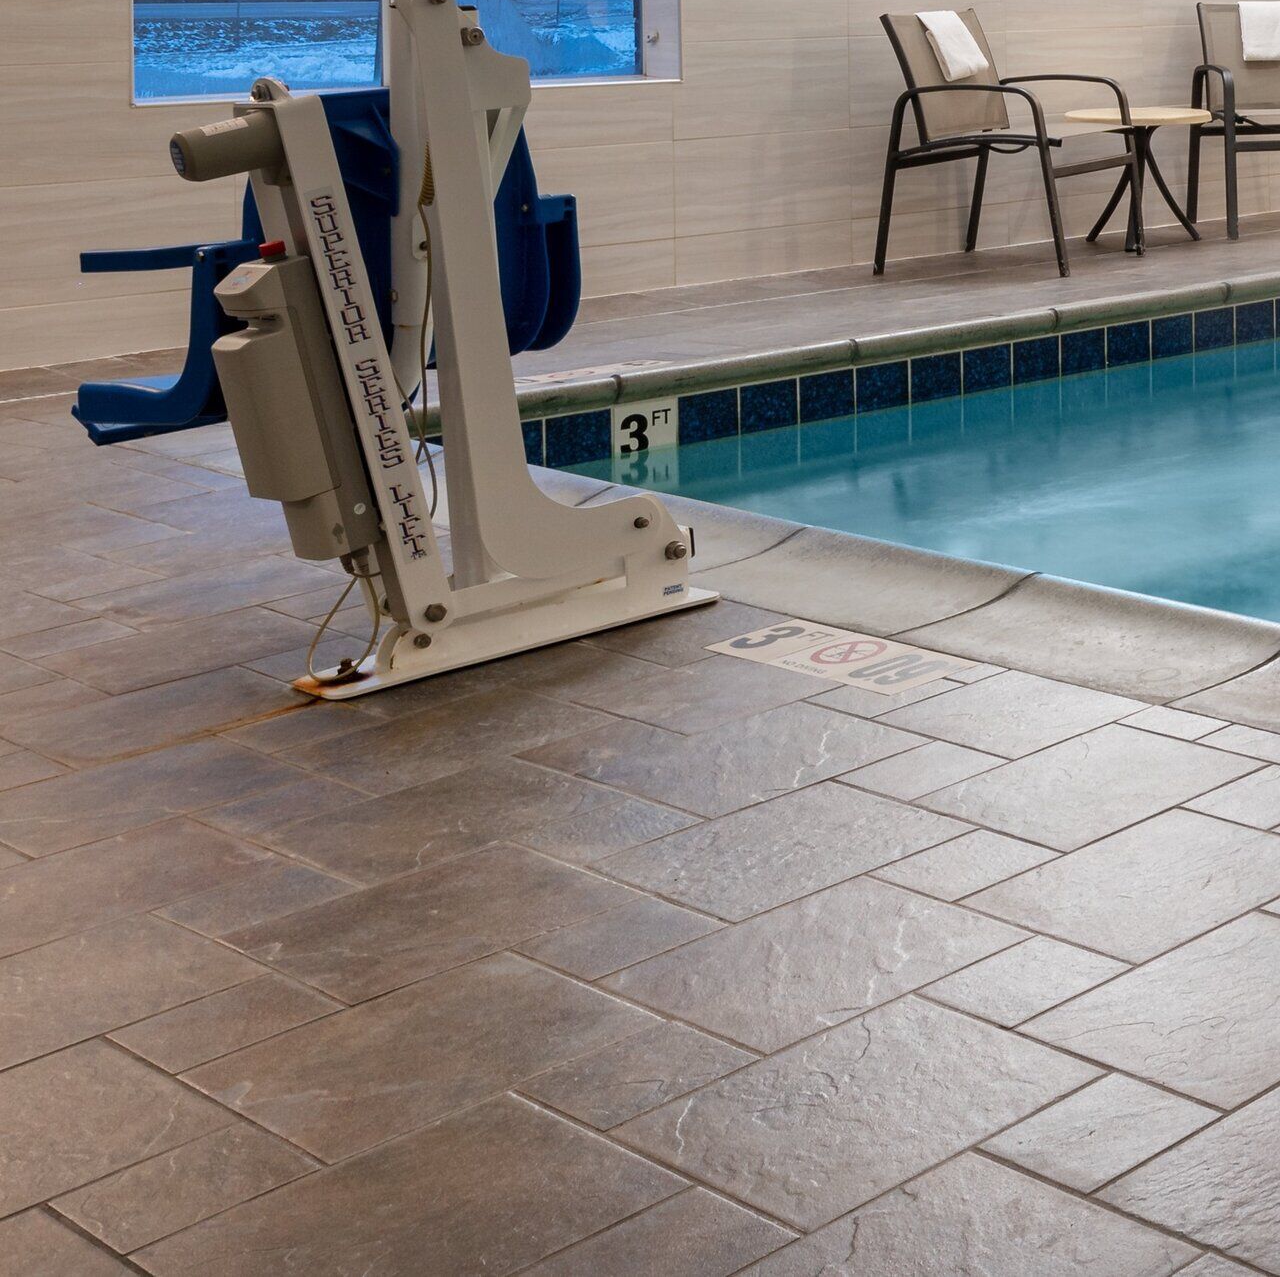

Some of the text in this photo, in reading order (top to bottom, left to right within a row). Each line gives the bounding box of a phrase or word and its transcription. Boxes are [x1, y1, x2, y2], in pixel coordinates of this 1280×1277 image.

[310, 195, 372, 345] SUPERIOR
[355, 358, 404, 469] SERIES
[389, 484, 427, 554] LIFT
